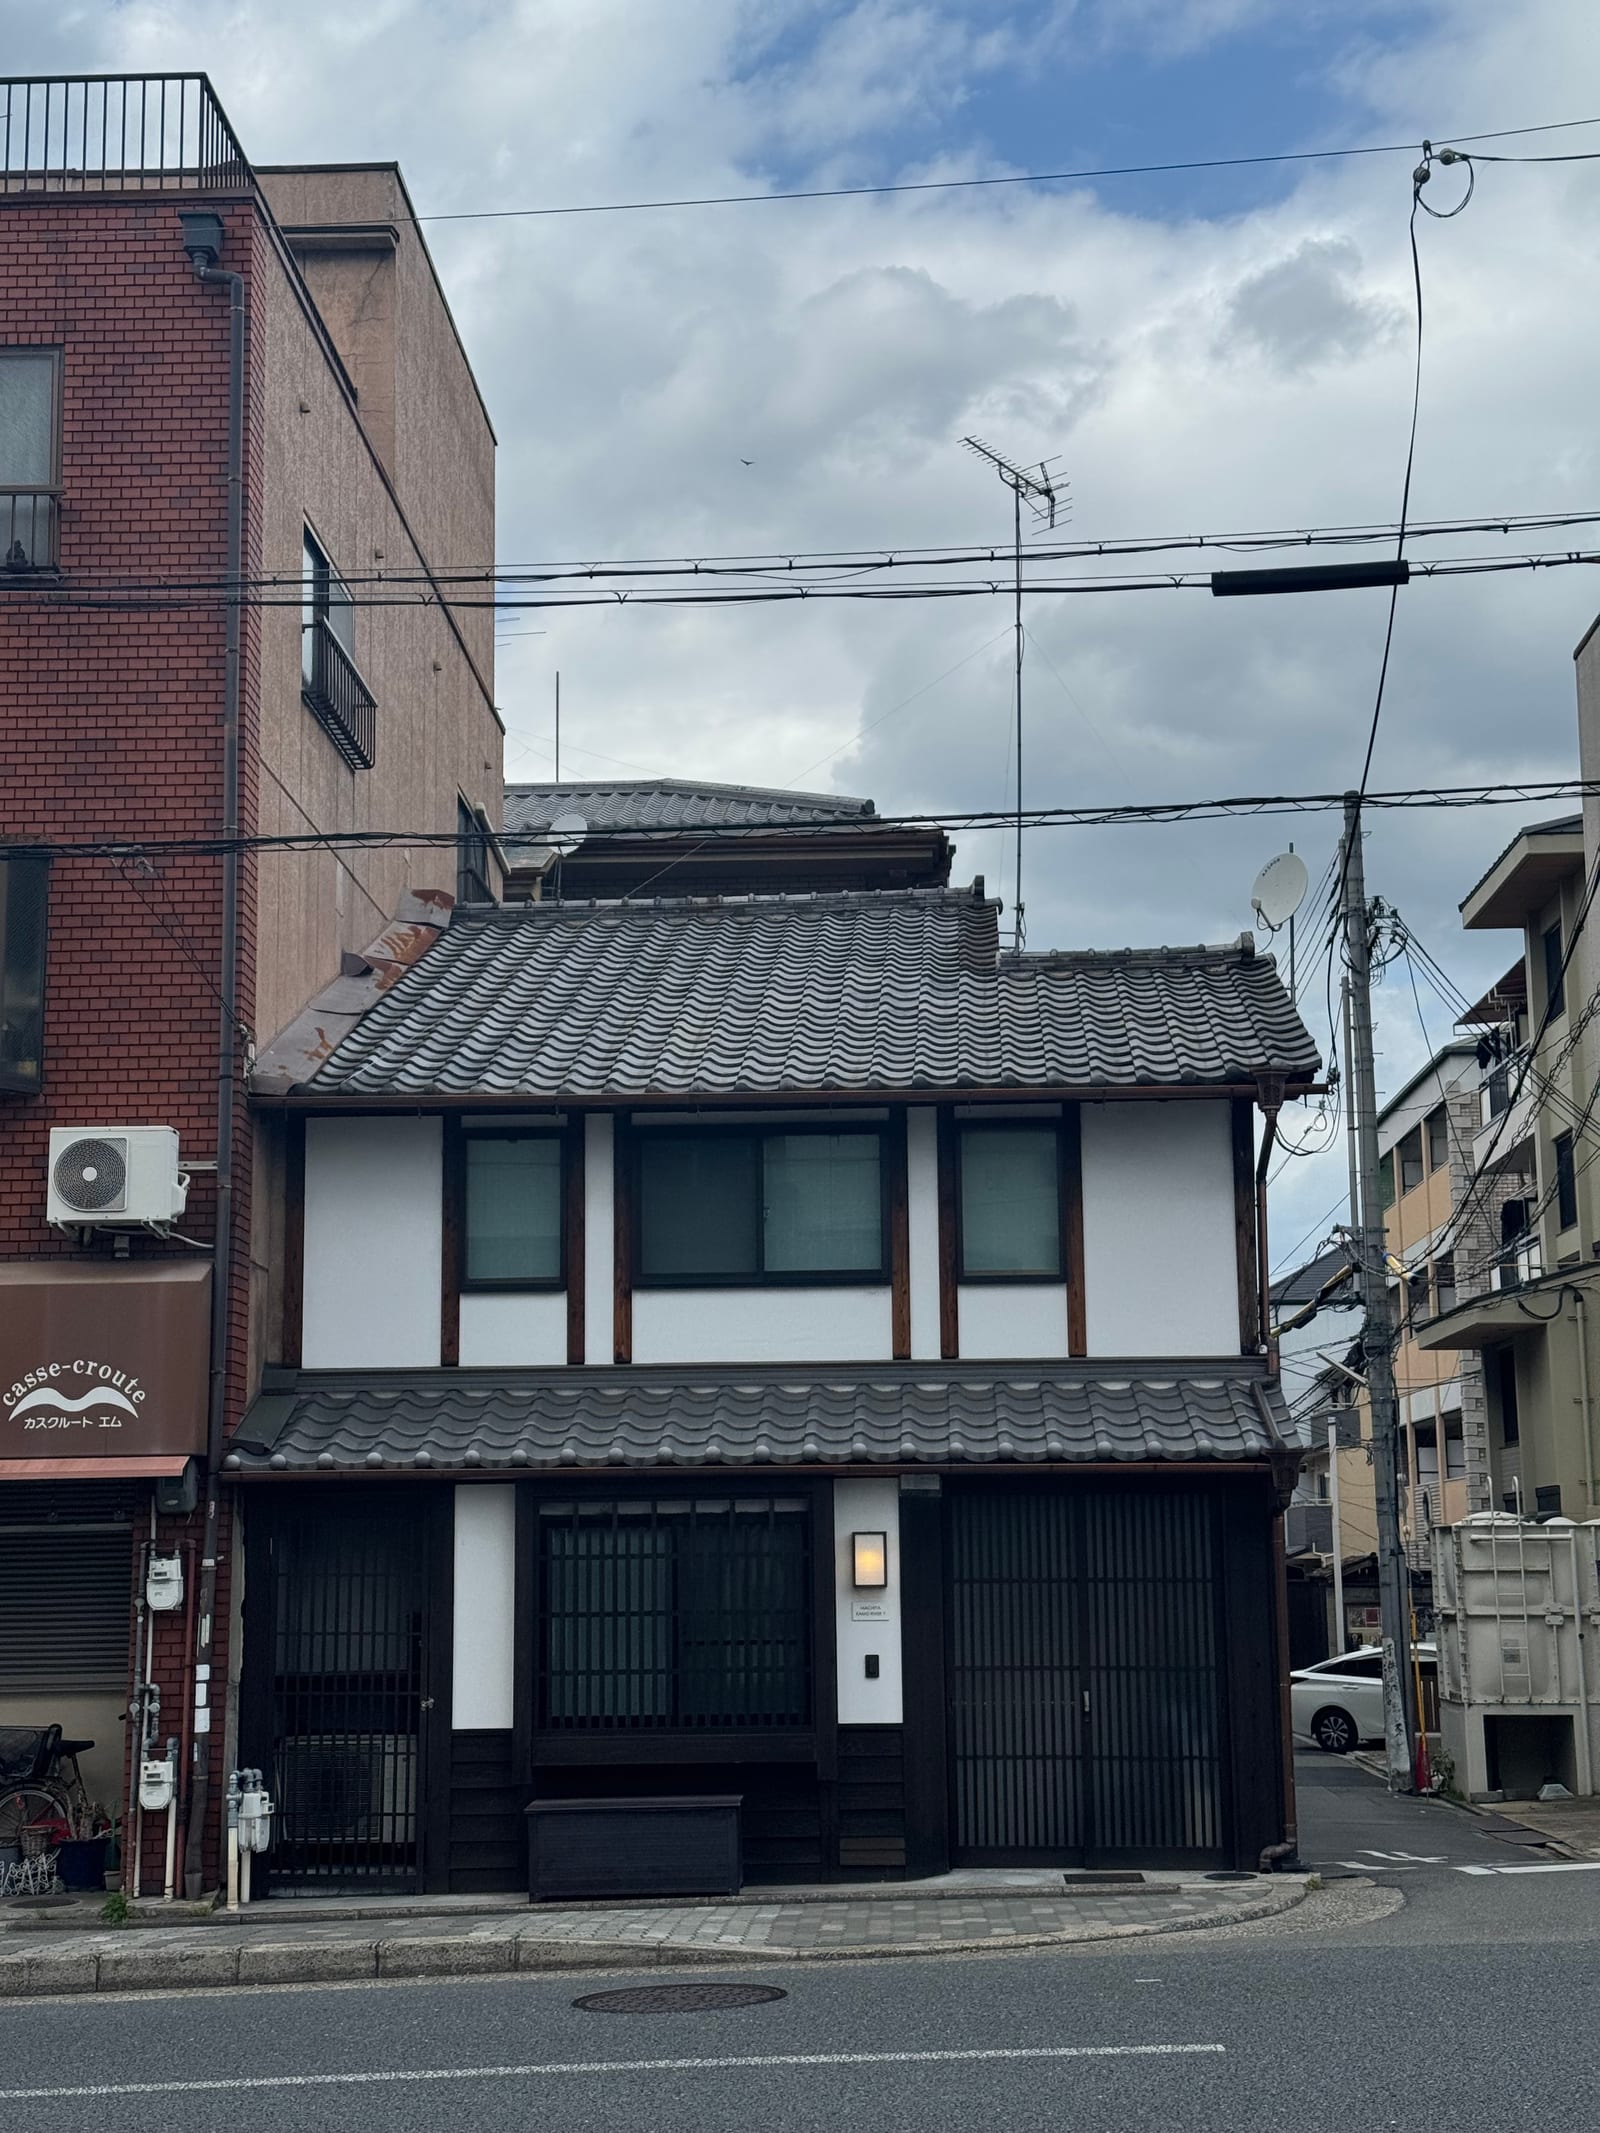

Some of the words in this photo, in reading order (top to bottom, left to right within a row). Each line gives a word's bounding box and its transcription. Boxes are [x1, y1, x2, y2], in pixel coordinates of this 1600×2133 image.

[2, 1359, 146, 1406] casse-croute
[24, 1416, 93, 1430] カスクルート
[98, 1416, 122, 1428] エム
